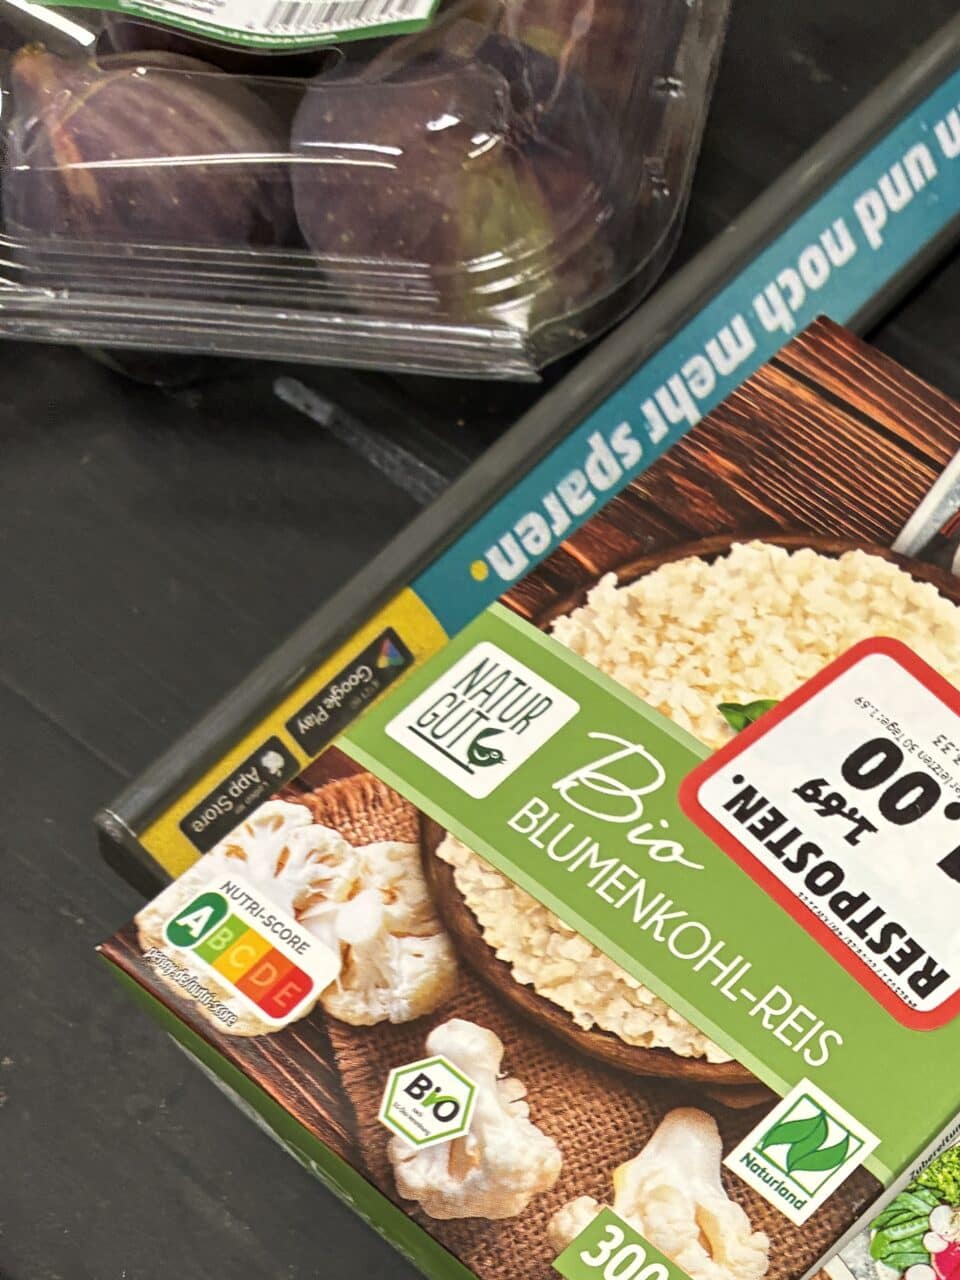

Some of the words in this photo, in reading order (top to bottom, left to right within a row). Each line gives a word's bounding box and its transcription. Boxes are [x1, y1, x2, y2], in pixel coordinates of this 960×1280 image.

[854, 152, 936, 246] und
[755, 220, 857, 333] noch
[641, 318, 757, 444] mehr
[470, 431, 644, 581] sparen.
[293, 702, 330, 738] Play
[319, 659, 376, 713] Google
[416, 692, 491, 750] GUT
[452, 657, 553, 735] NATUR
[189, 792, 235, 837] Store
[225, 763, 264, 802] App
[552, 731, 704, 871] Bio
[219, 880, 311, 956] NUTRI-SCORE
[722, 774, 951, 1000] RESTPOSTEN.
[176, 904, 213, 938] A
[208, 926, 234, 950] B
[229, 945, 255, 968] C
[250, 963, 278, 987] D
[273, 981, 302, 1008] E
[508, 797, 843, 1068] BLUMENKOHL-REIS
[740, 1152, 808, 1211] Naturland
